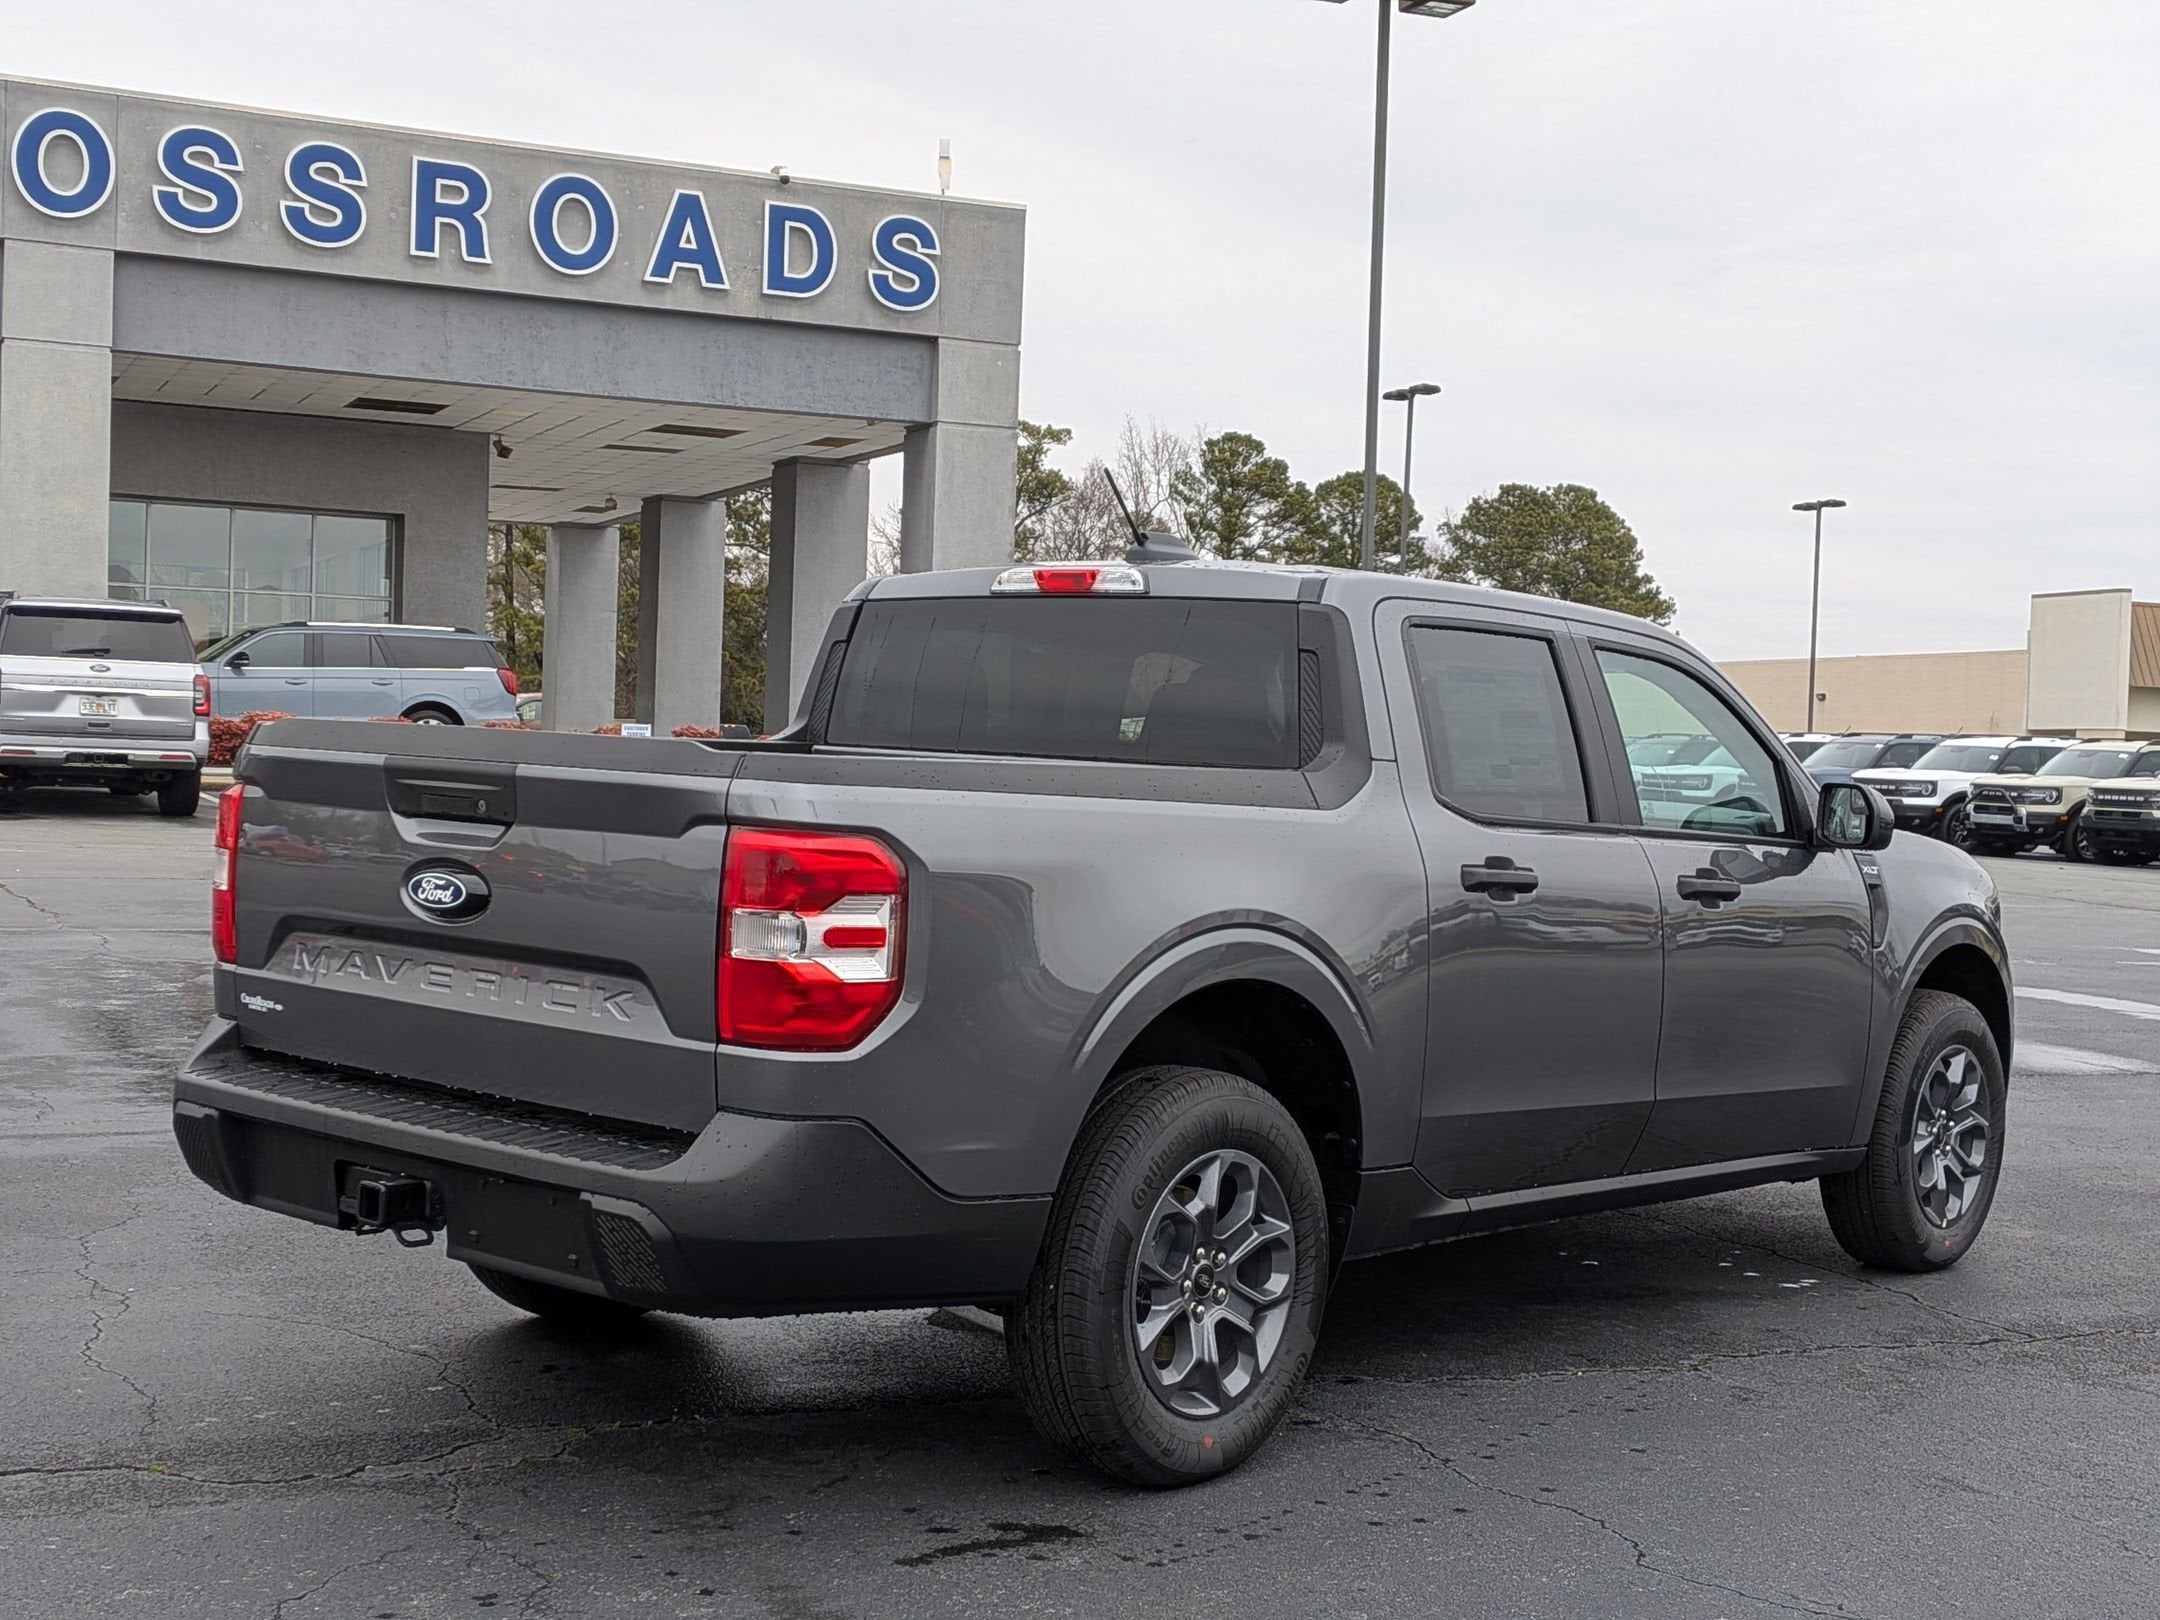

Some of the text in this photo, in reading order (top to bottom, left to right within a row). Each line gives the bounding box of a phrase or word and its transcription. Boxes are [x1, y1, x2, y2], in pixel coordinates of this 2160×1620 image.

[10, 107, 942, 313] OSSROADS
[415, 875, 458, 904] Ford
[1861, 864, 1879, 874] XLT
[292, 942, 634, 1022] MAVERICK
